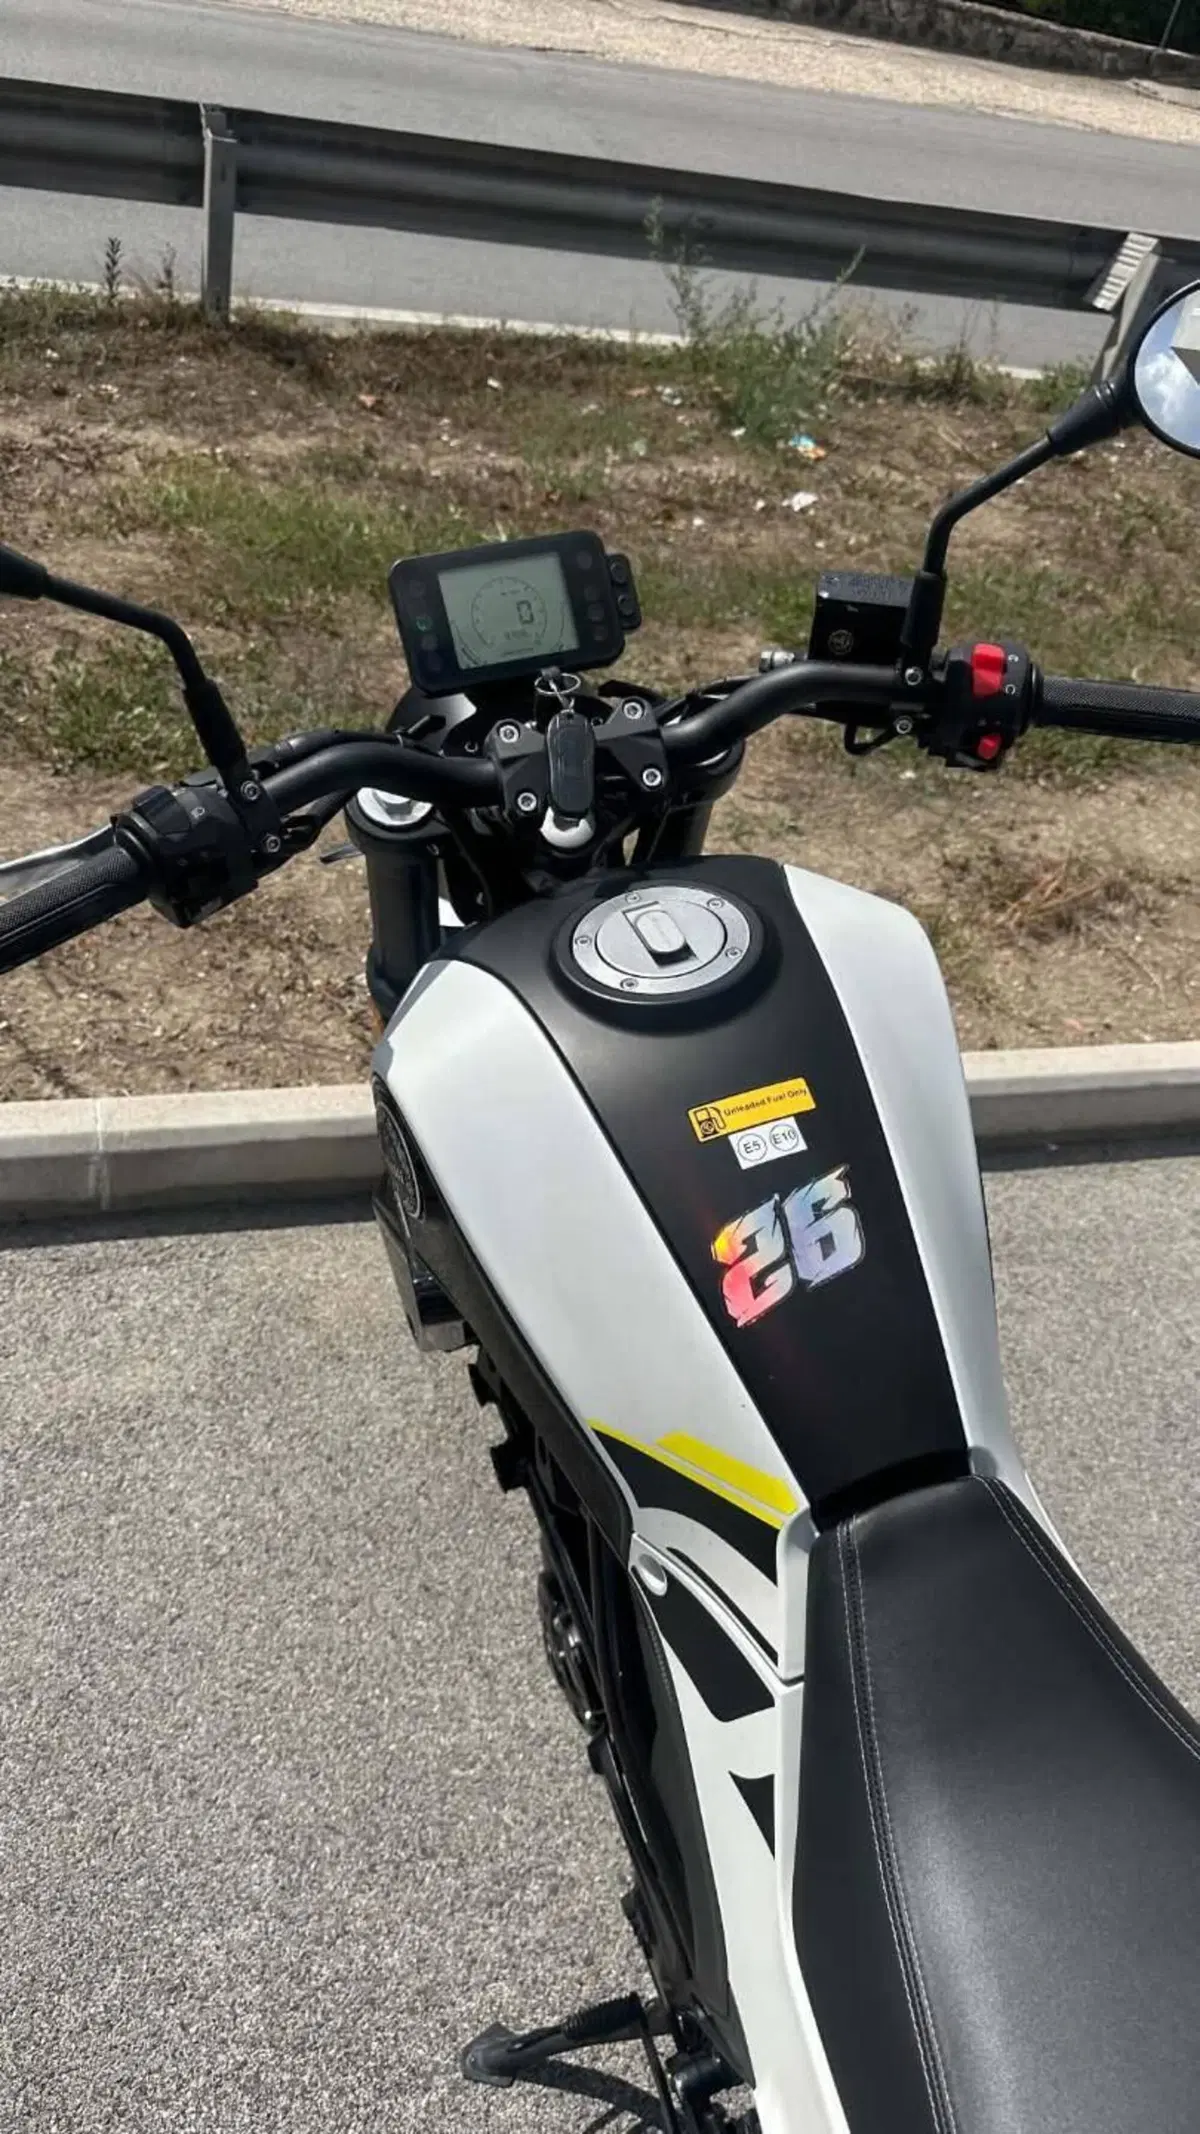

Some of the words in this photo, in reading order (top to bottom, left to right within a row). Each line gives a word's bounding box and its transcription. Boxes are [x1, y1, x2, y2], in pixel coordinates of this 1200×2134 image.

[723, 1099, 766, 1116] Unleaded
[766, 1094, 787, 1105] Fuel
[787, 1088, 807, 1099] Only
[743, 1139, 761, 1154] E5
[772, 1129, 797, 1144] E10
[710, 1164, 866, 1328] 26
